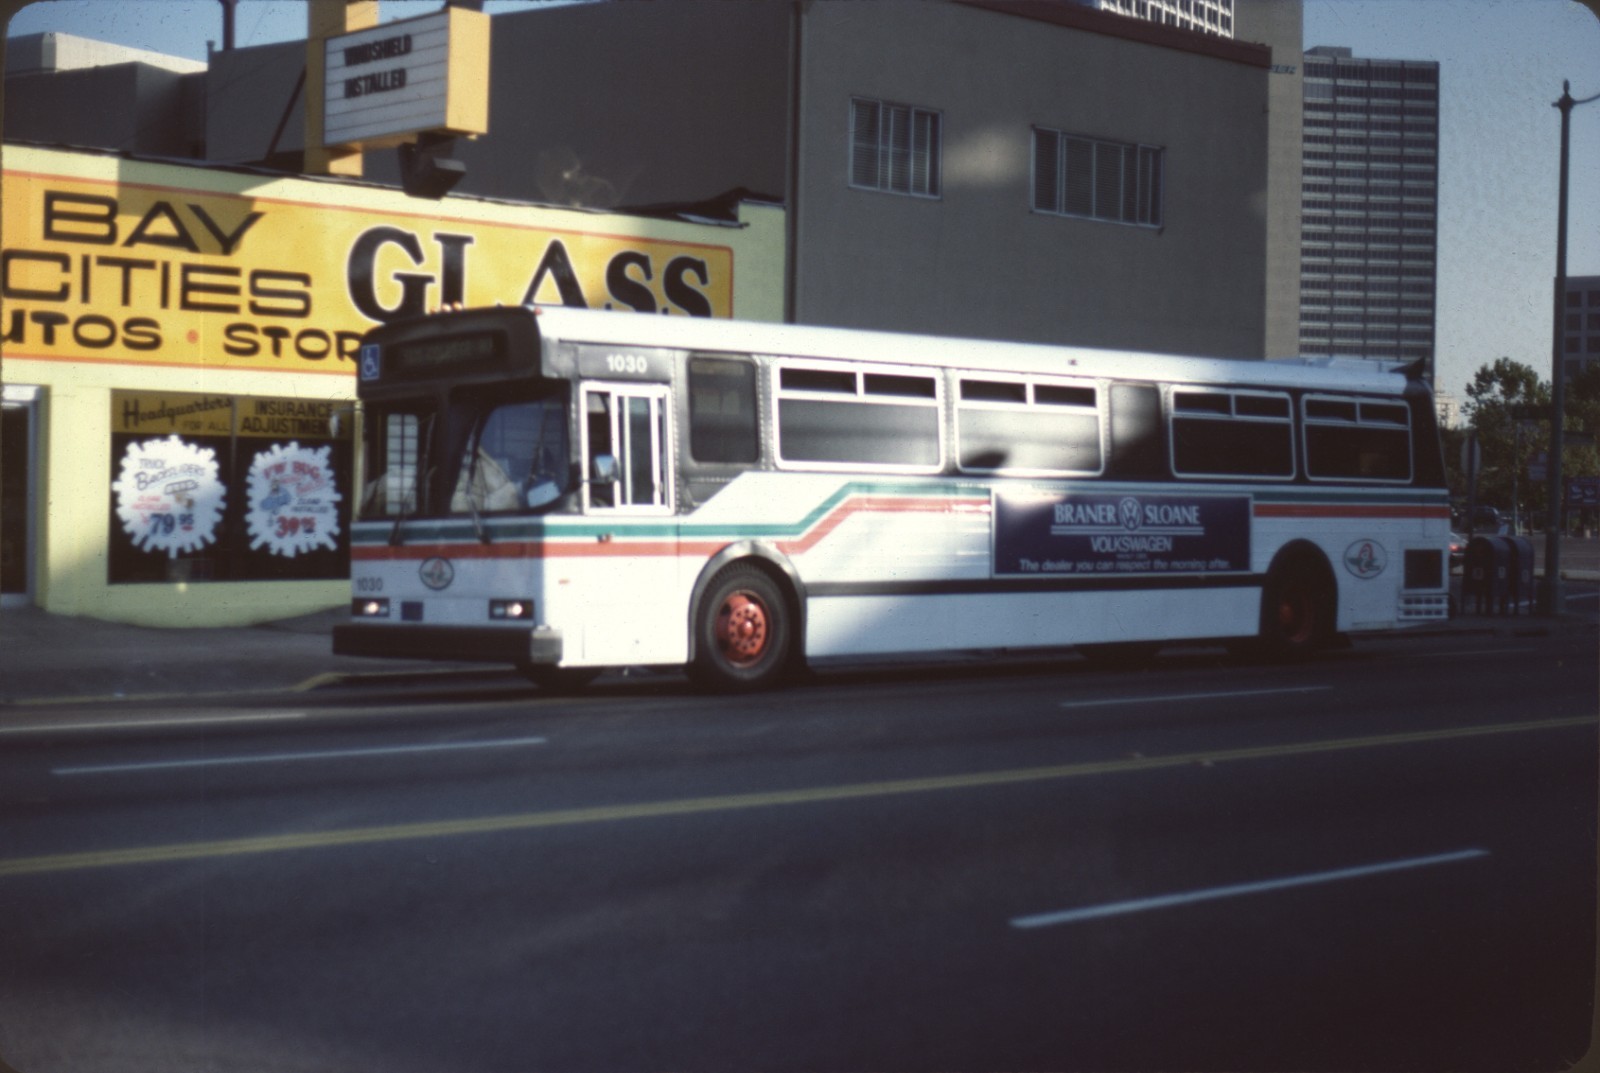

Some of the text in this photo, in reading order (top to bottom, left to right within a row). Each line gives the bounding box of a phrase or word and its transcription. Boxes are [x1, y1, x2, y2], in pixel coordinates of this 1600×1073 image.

[43, 189, 266, 255] BAY
[2, 249, 312, 318] CITIES
[606, 354, 648, 374] 1030
[123, 397, 233, 429] Headquarters
[255, 400, 333, 416] INSURANCE
[1054, 504, 1117, 525] BRANER
[1146, 505, 1200, 525] SLOANE
[1090, 536, 1173, 552] VOLKSWAGEN
[1019, 559, 1039, 571] The
[1042, 559, 1073, 571] dealer
[1076, 561, 1096, 572] you
[1097, 561, 1114, 570] can
[1153, 559, 1168, 570] the
[356, 576, 383, 592] 1030
